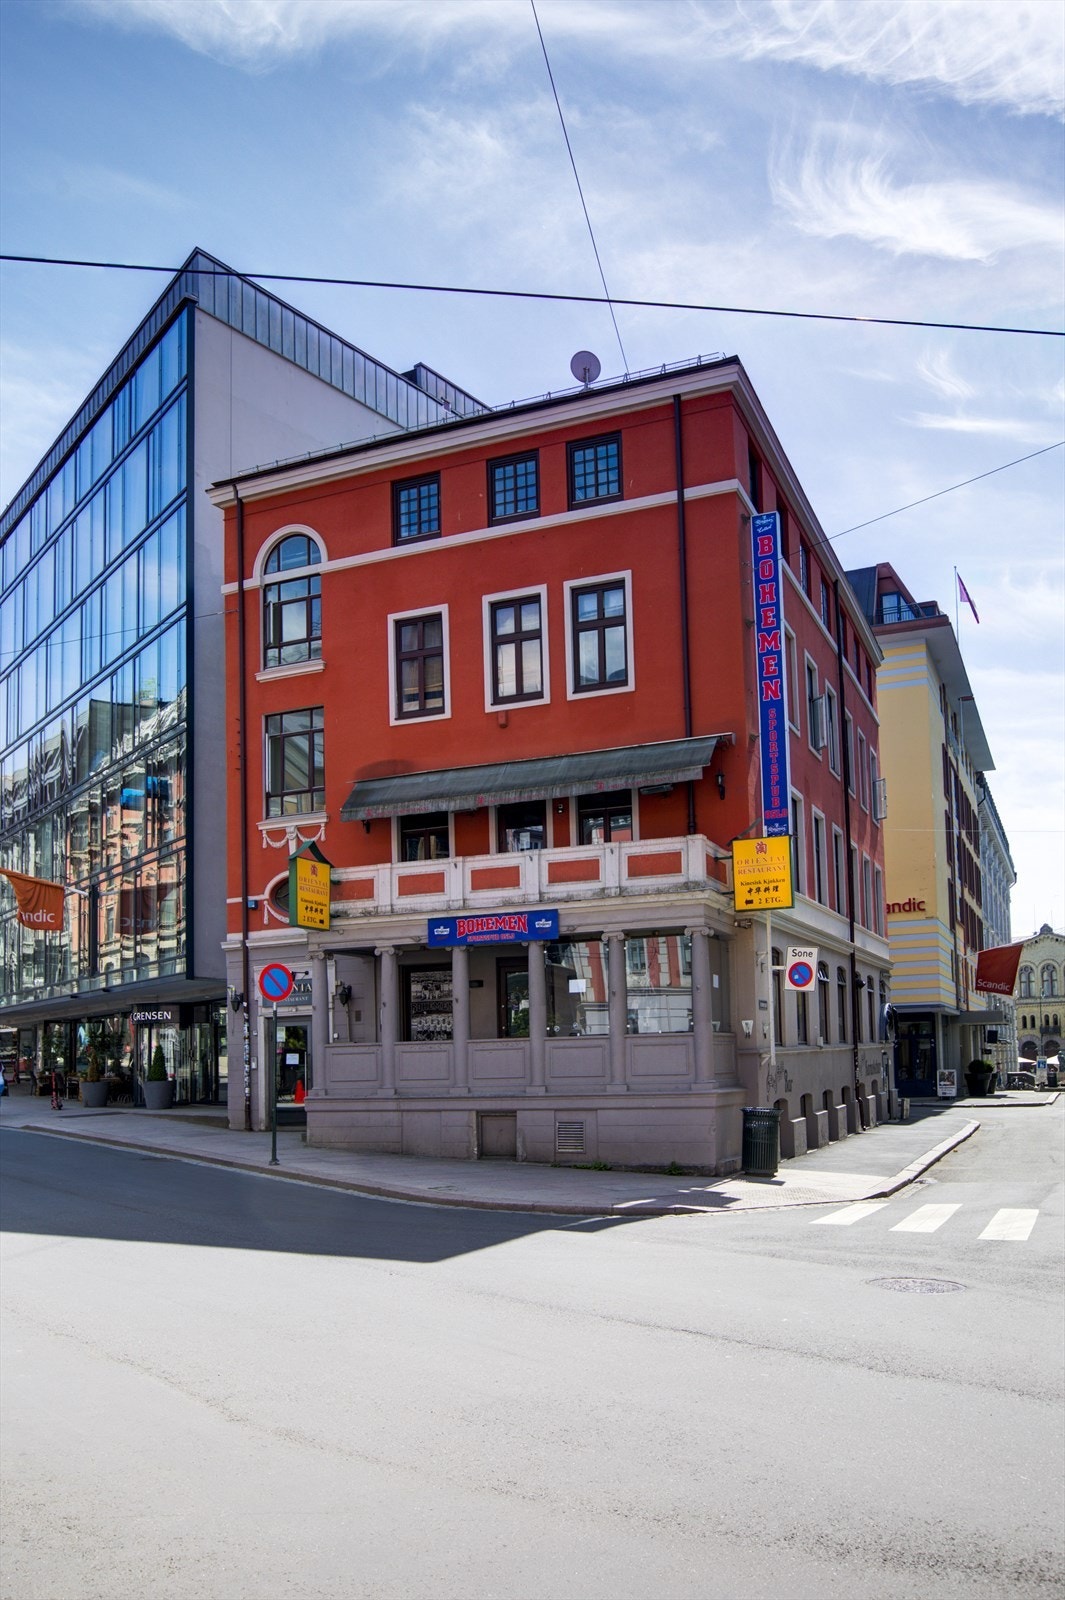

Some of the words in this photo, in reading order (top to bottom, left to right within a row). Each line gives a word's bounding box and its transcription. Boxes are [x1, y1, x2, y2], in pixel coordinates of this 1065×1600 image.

[758, 535, 781, 700] BOHEMEN
[767, 708, 780, 808] SPORTSPUB
[737, 855, 785, 865] ORIENTAL
[738, 865, 786, 875] RESTAURANT
[299, 876, 328, 888] ORIENTAL
[456, 914, 528, 938] BOHEMEN
[791, 948, 813, 958] Sone
[977, 978, 1011, 991] Scandic
